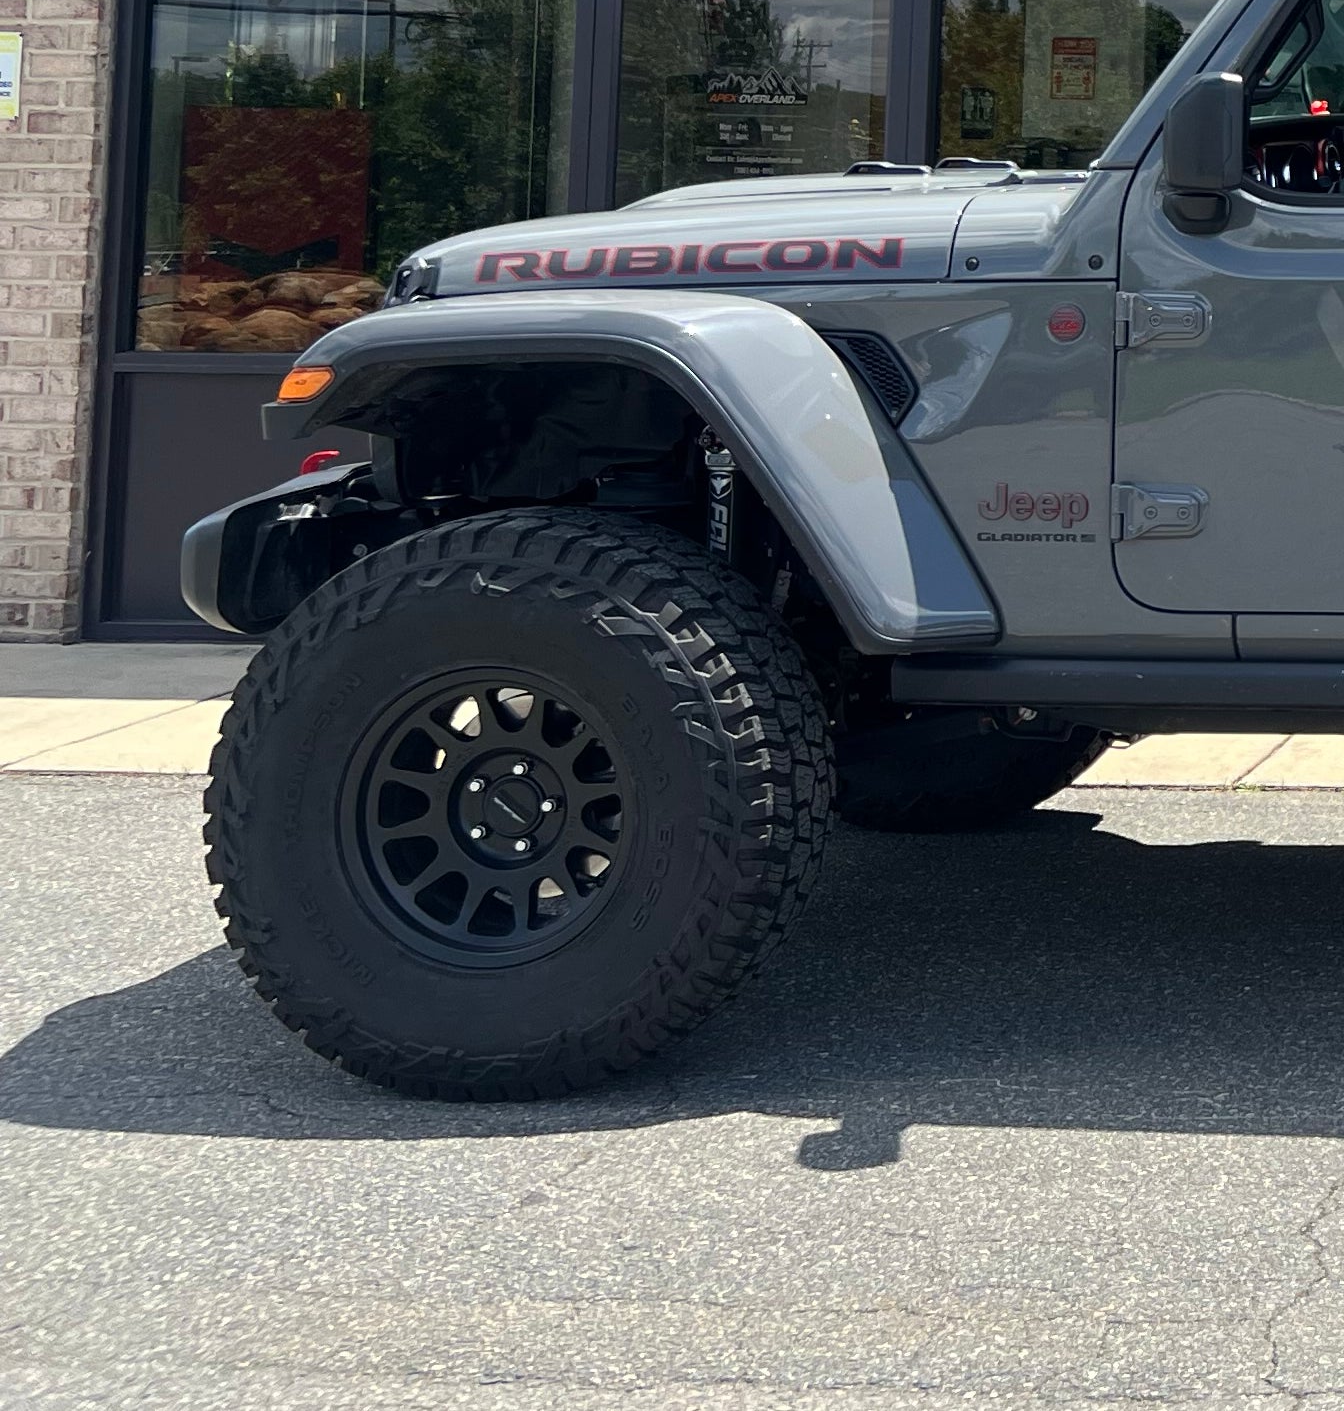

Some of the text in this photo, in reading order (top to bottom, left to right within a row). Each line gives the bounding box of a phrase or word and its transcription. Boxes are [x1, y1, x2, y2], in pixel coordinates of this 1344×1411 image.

[709, 93, 737, 103] APEX
[475, 237, 904, 283] RUBICON
[978, 482, 1090, 528] Jeep
[977, 532, 1078, 543] GLADIATOR
